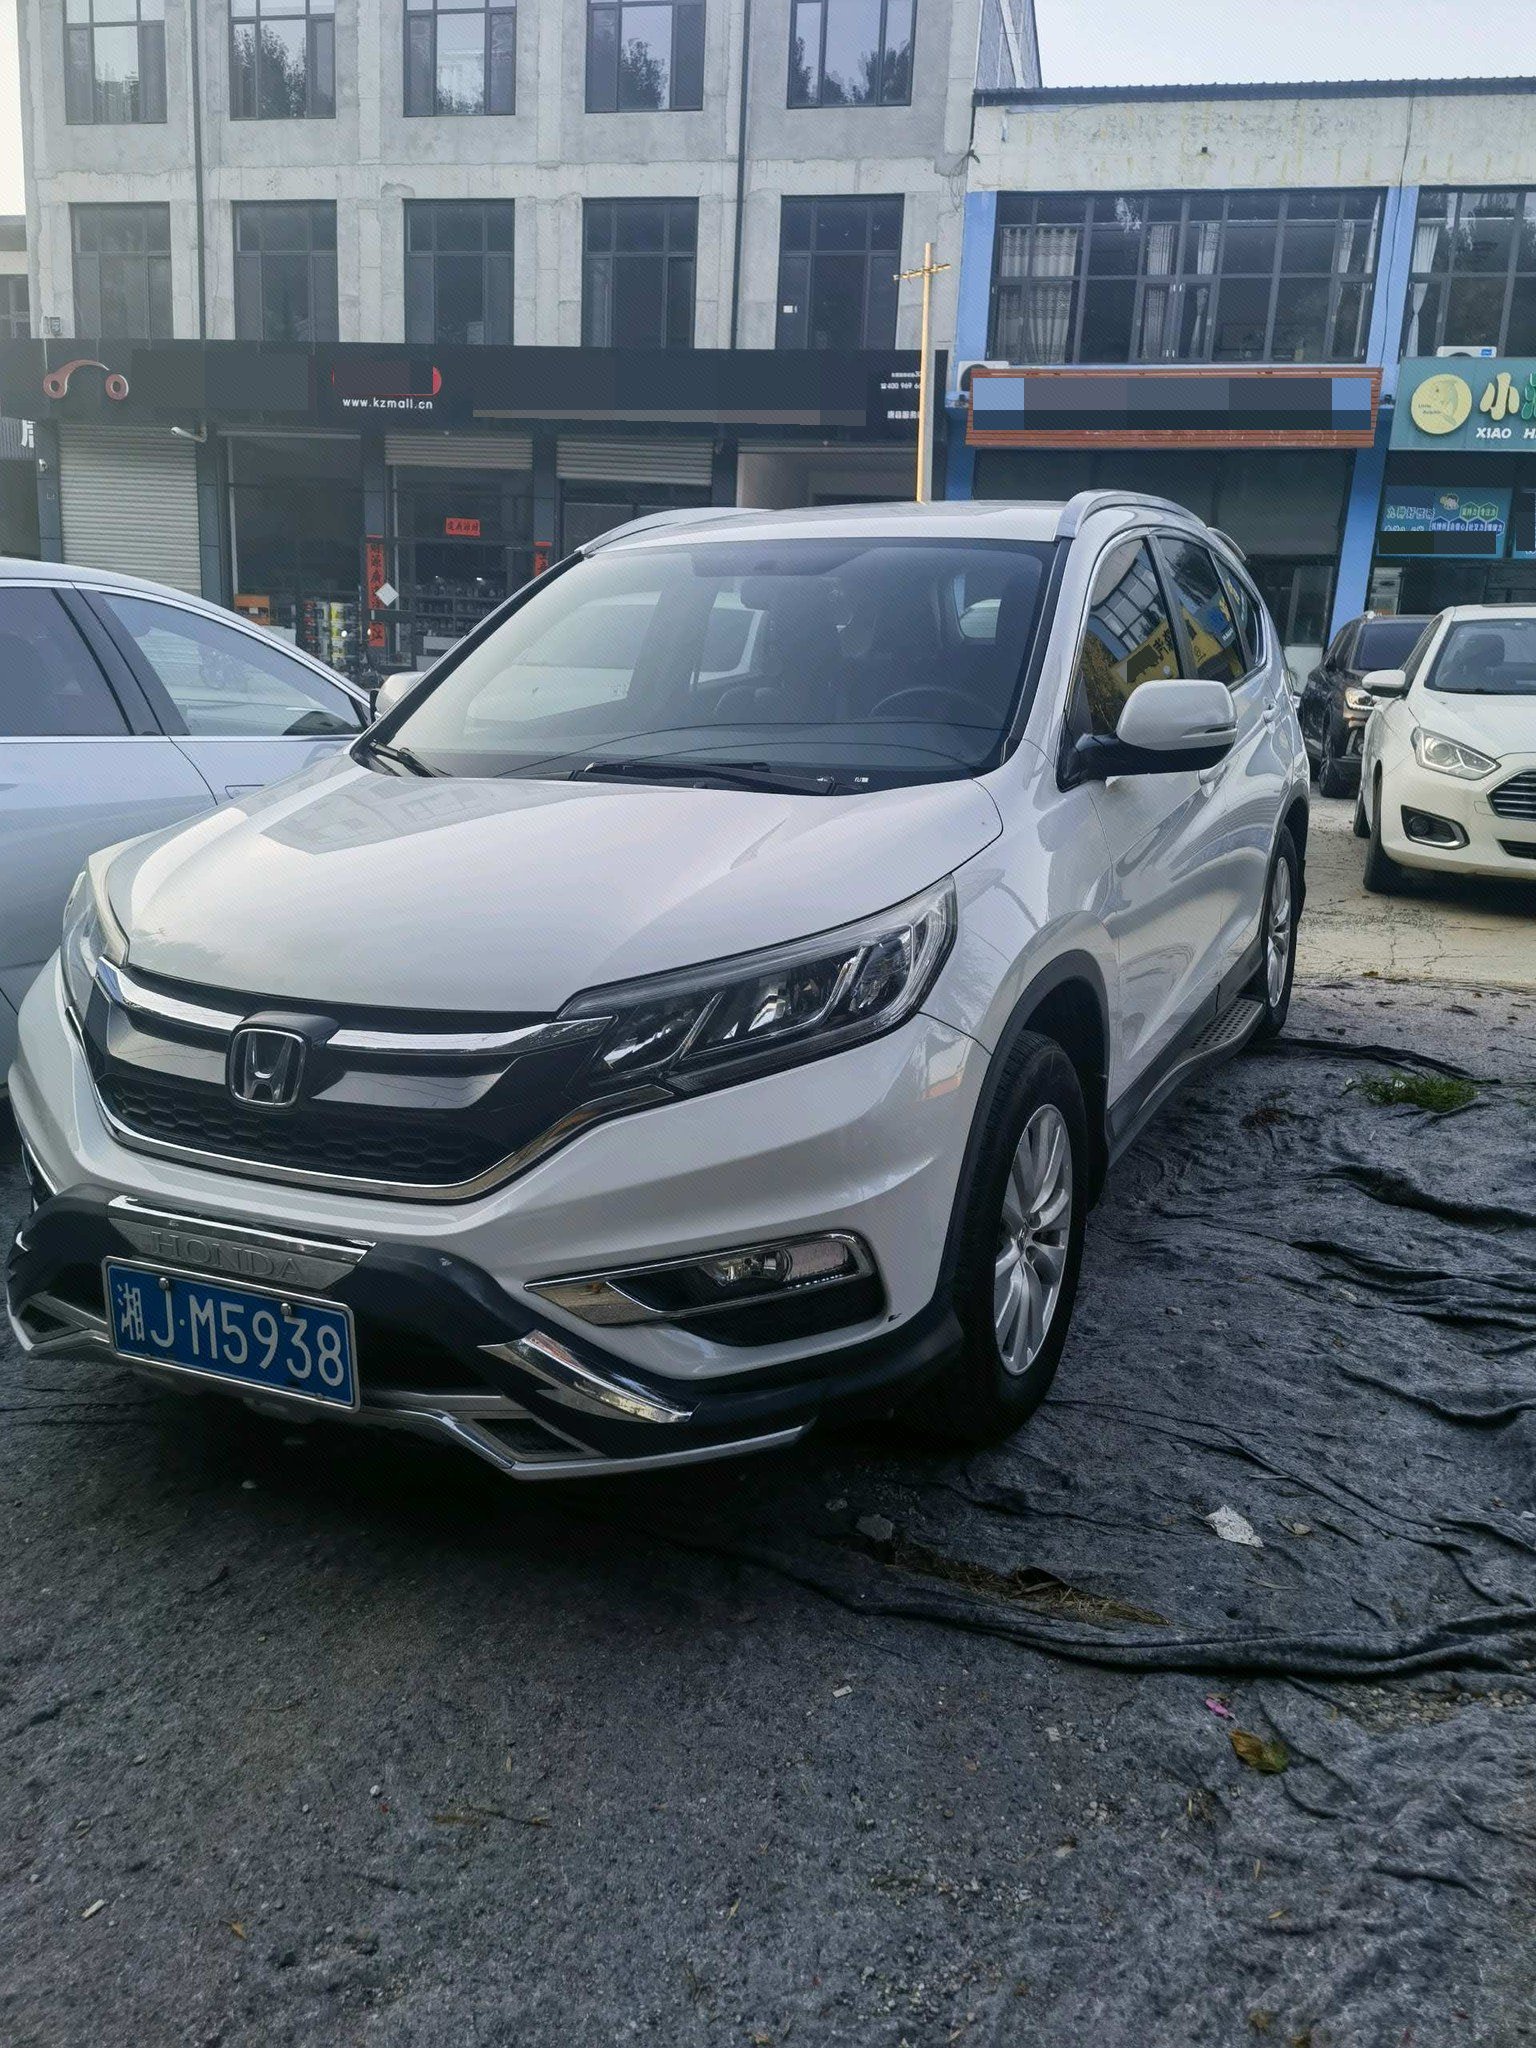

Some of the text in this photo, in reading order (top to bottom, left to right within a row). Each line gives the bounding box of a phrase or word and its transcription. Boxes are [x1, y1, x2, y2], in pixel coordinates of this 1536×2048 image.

[342, 397, 433, 410] www.kzmall.cn
[1479, 371, 1536, 421] 小
[1476, 427, 1536, 439] XIAO H
[151, 1231, 302, 1281] HONDA
